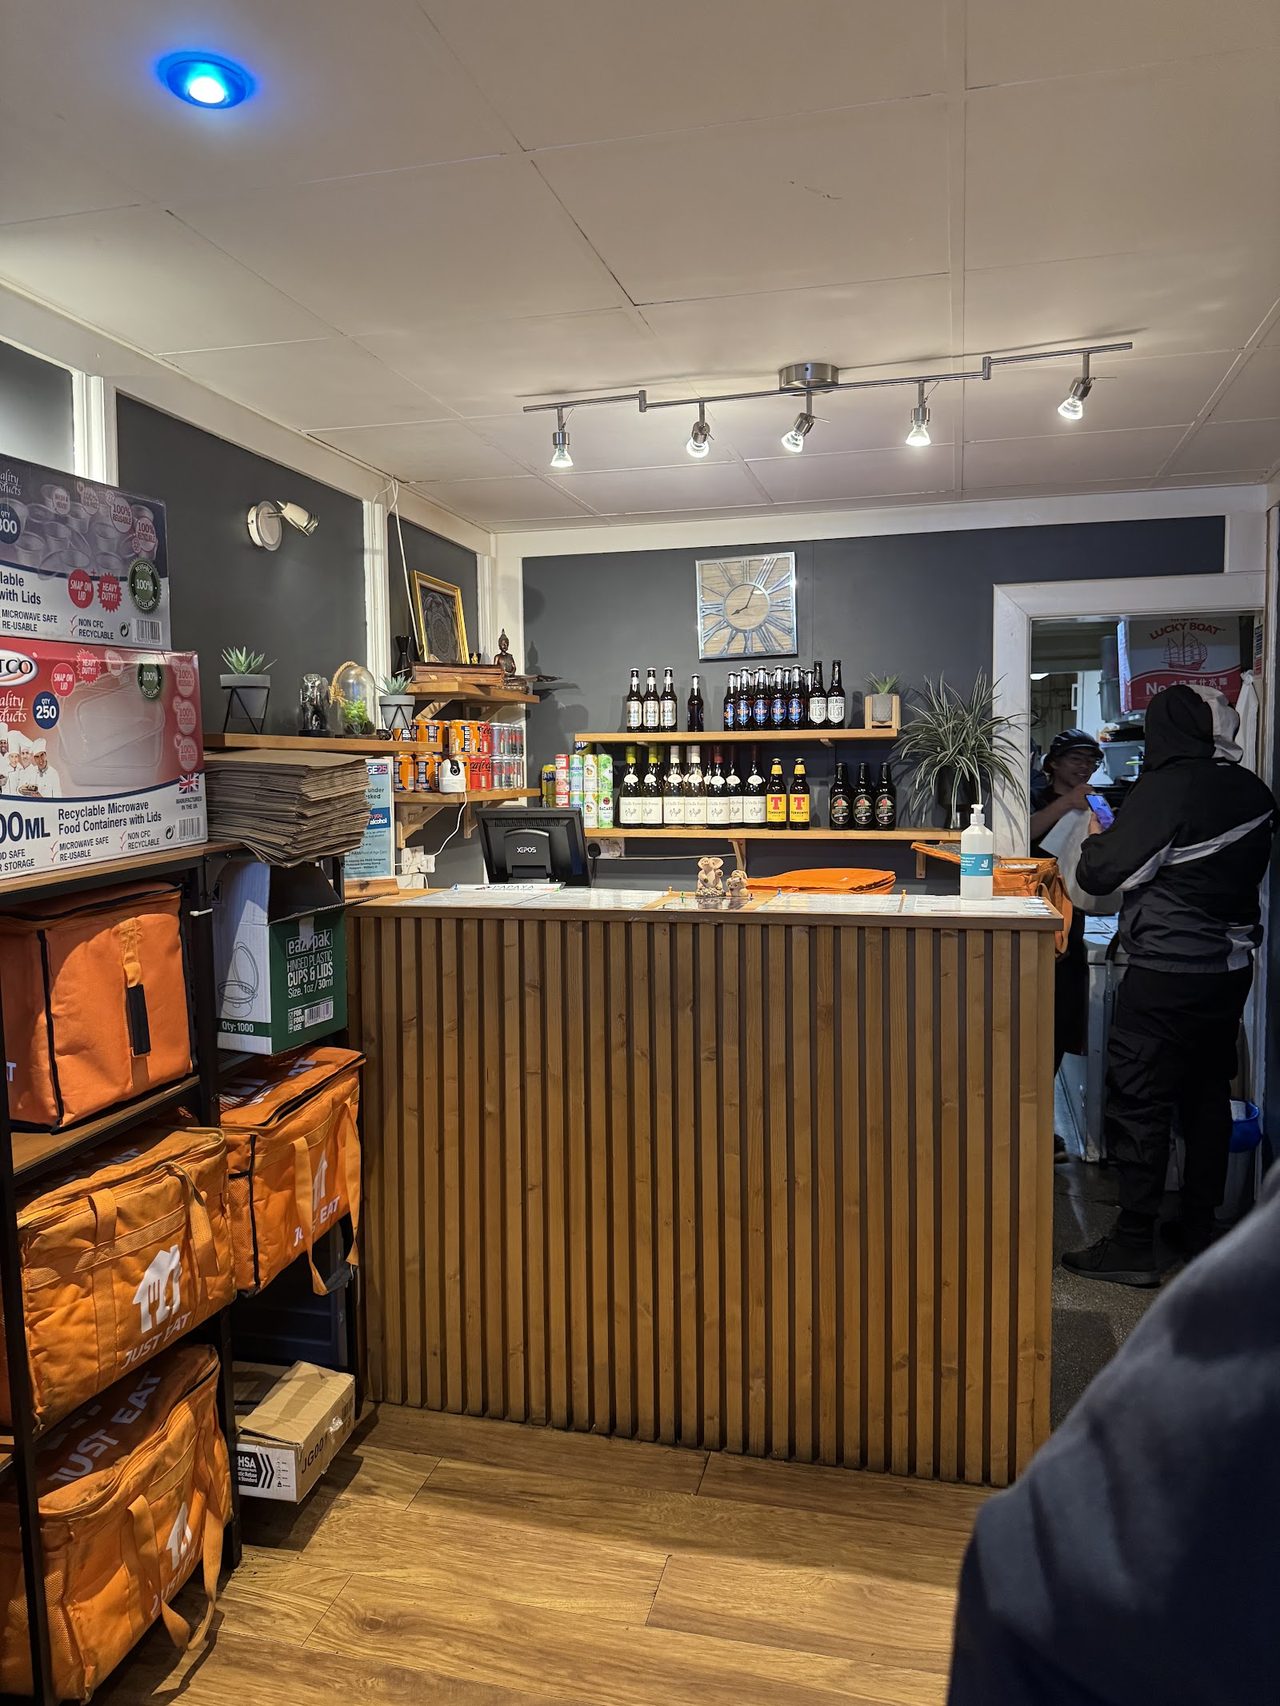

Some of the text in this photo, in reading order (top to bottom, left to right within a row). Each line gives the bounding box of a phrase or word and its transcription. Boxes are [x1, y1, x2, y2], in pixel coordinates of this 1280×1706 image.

[0, 571, 24, 587] lable
[136, 579, 153, 592] 100%
[70, 579, 92, 593] SNAP ON
[102, 582, 118, 592] HEAVY
[0, 588, 41, 605] with Lids
[77, 591, 87, 601] LID
[2, 609, 58, 624] MICROWAVE SAFE
[2, 620, 38, 632] RE-USABLE
[78, 618, 104, 629] NON CFC
[78, 628, 114, 640] RECYCLABLE
[1149, 622, 1218, 640] LUCKY BOAT
[53, 673, 74, 682] SNAP ON
[143, 671, 158, 681] 100%
[60, 682, 69, 691] LID
[41, 698, 51, 706] QTY
[36, 705, 57, 719] 250
[771, 797, 782, 810] T
[794, 797, 805, 810] T
[58, 801, 149, 821] Recyclable Microwave
[58, 811, 162, 835] Food Containers with Lids
[127, 830, 151, 840] NON CFC
[59, 836, 109, 851] MICROWAVE SAFE
[127, 838, 160, 850] RECYCLABLE
[9, 848, 26, 859] SAFE
[59, 849, 91, 861] RE-USABLE
[4, 858, 35, 871] STORAGE
[287, 949, 333, 973] HINGED PLASTIC
[287, 961, 334, 987] CUPS & LIDS
[320, 1195, 340, 1224] EAT
[121, 1311, 191, 1370] JUST EAT
[110, 1371, 162, 1425] EAT
